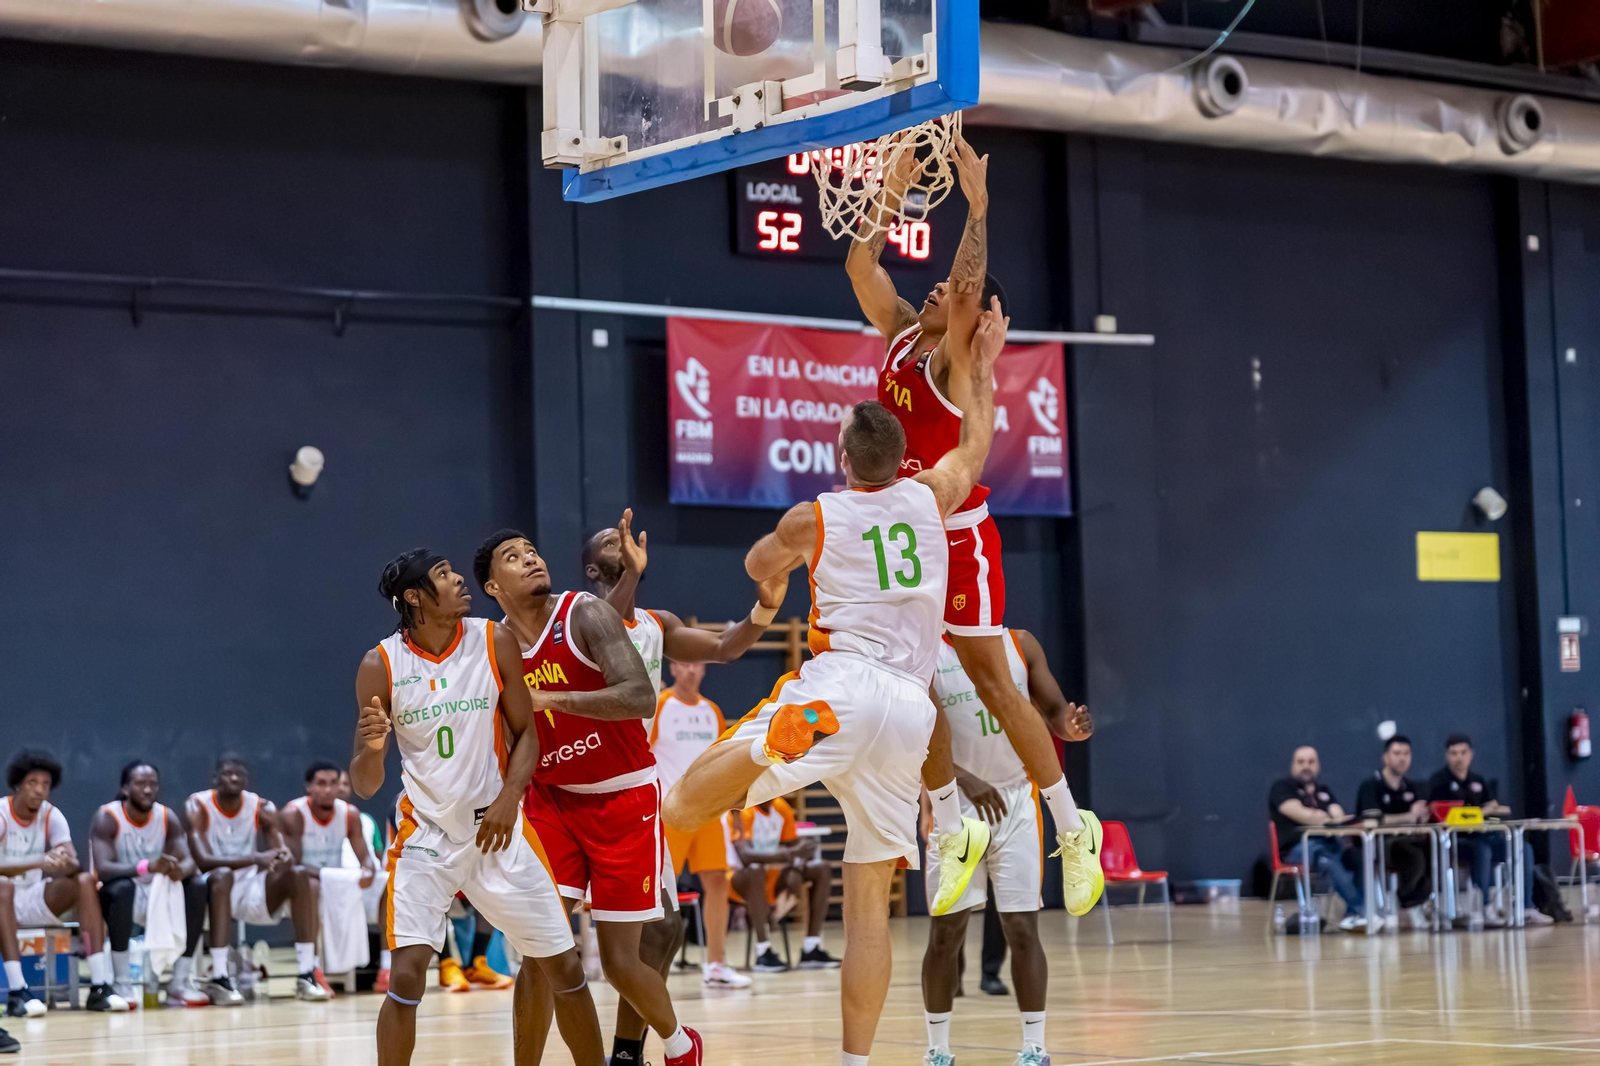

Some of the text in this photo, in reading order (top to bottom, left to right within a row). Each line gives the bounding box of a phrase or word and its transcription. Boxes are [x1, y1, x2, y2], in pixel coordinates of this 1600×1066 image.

[747, 181, 802, 204] LOCAL
[757, 210, 802, 252] 52
[887, 221, 931, 260] 40
[748, 355, 774, 377] EN
[777, 357, 800, 379] LA
[736, 395, 761, 418] EN
[763, 397, 789, 420] LA
[675, 419, 713, 440] FBM
[768, 438, 836, 475] CON
[861, 522, 922, 591] 13
[397, 697, 489, 726] CÔTE D'IVOIRE
[940, 691, 973, 709] CÔTE
[975, 709, 1004, 737] 10
[436, 725, 454, 759] 0
